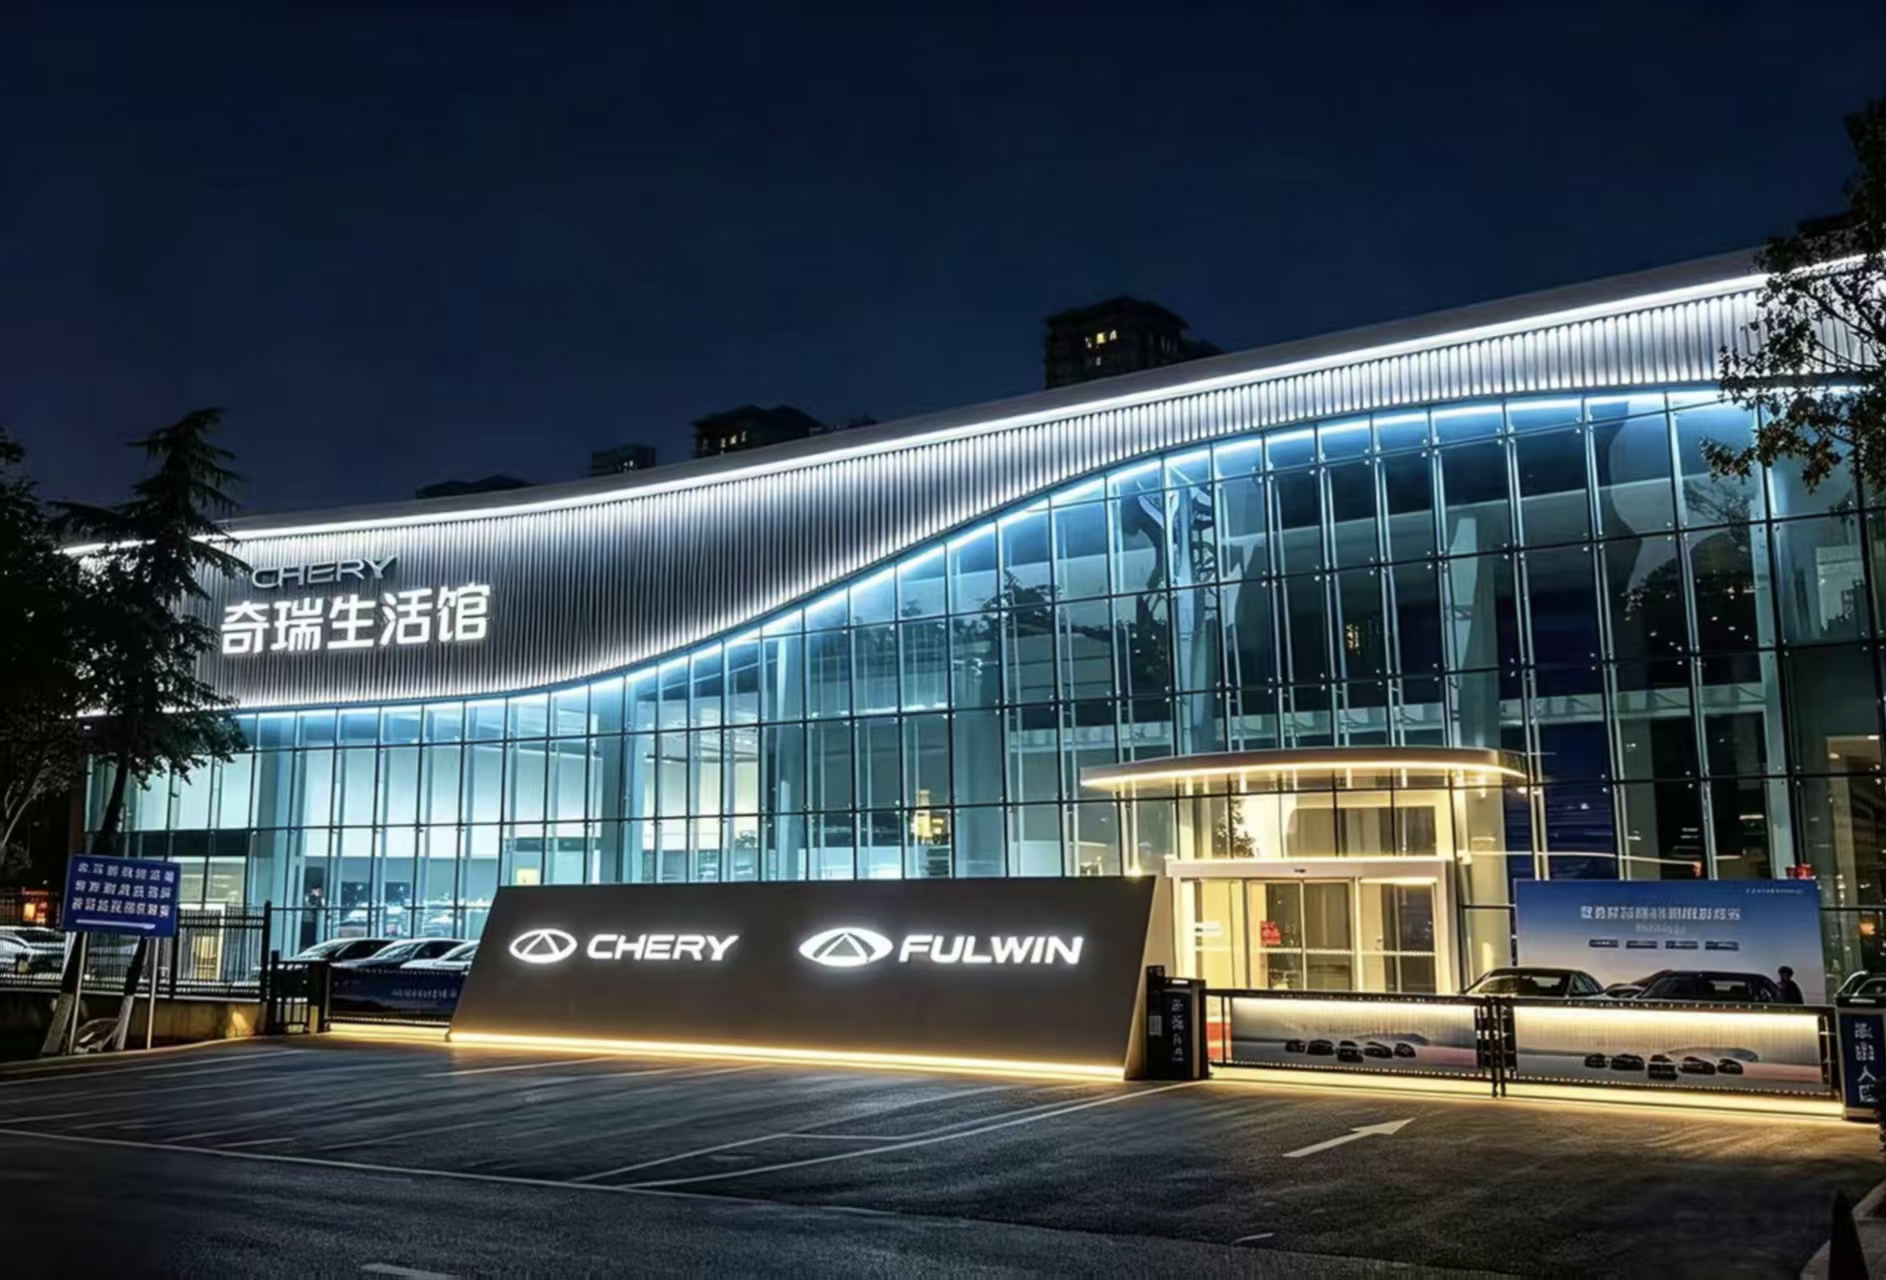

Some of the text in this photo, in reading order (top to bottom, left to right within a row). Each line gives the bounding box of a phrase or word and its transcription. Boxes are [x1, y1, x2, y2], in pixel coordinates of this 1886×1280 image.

[251, 554, 398, 589] CHERY
[221, 583, 491, 655] 奇瑞生活馆
[586, 933, 739, 962] CHERY
[898, 934, 1084, 965] FULWIN
